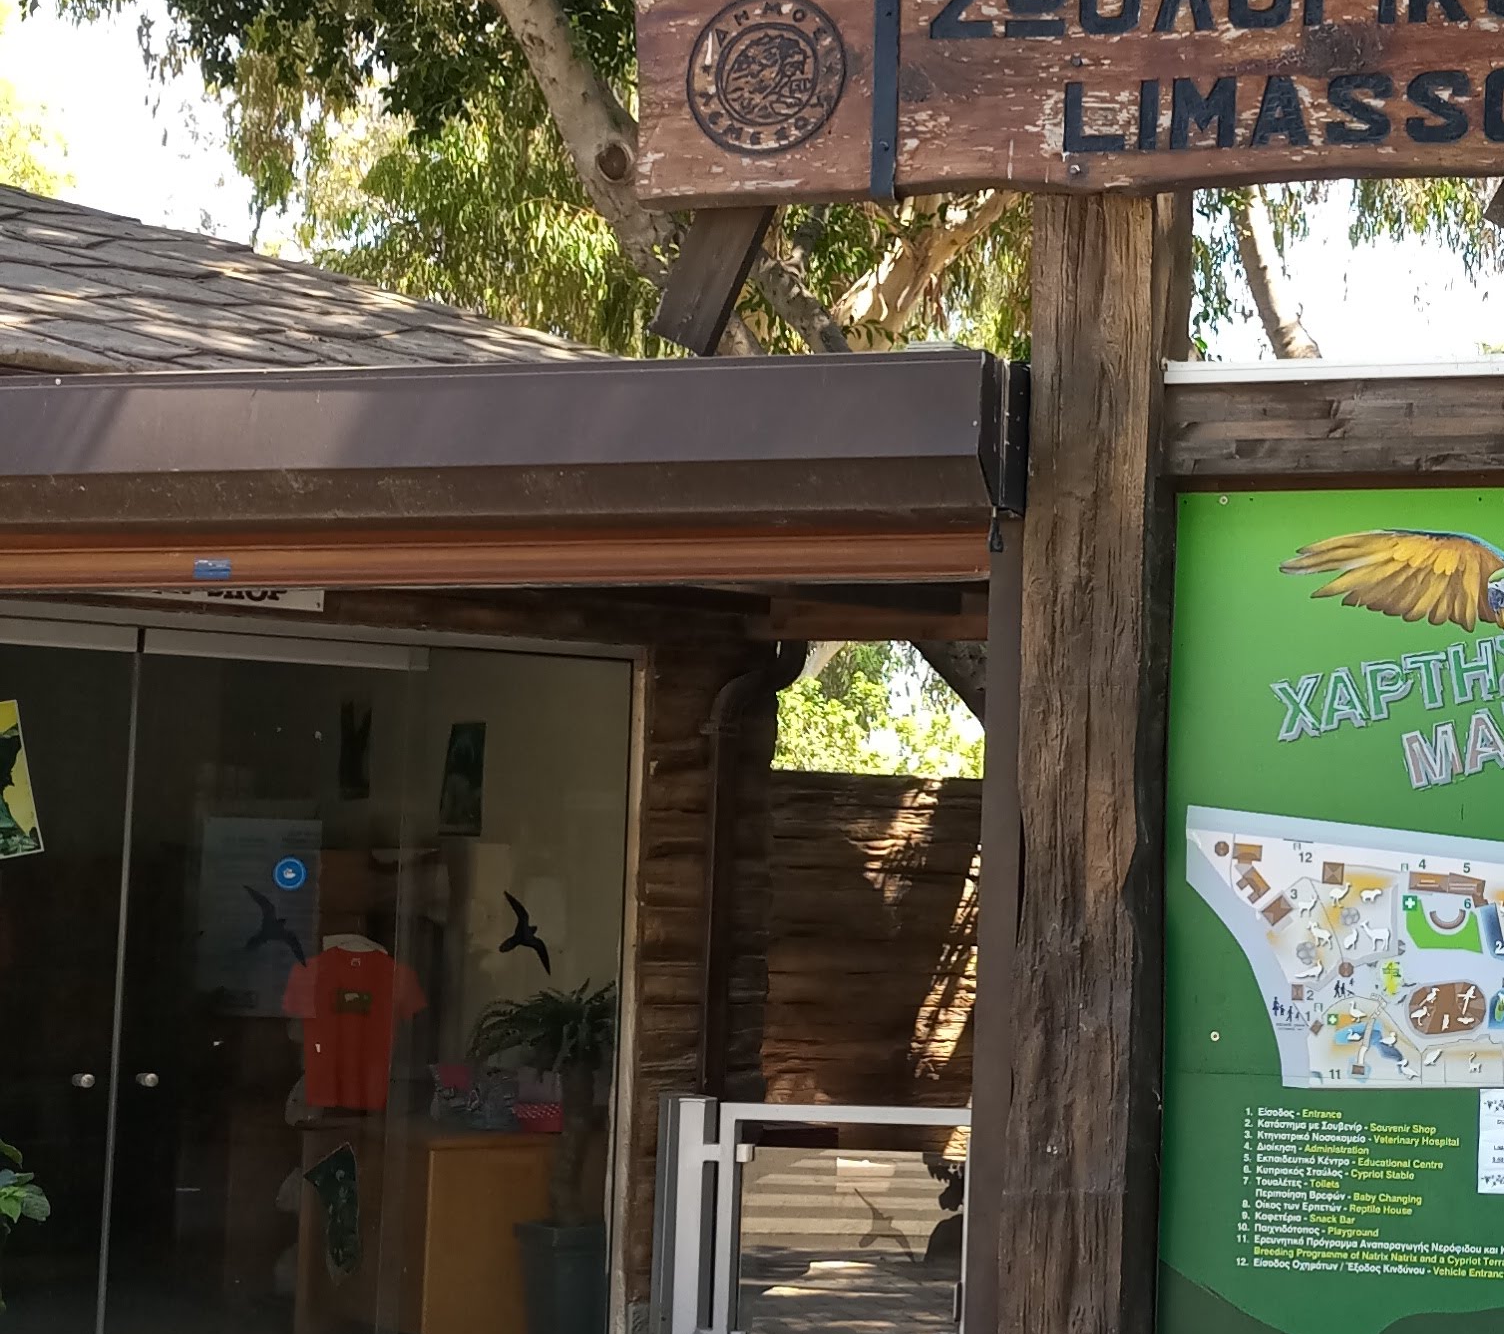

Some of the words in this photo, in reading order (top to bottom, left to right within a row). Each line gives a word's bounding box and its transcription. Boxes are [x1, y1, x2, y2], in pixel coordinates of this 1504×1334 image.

[1298, 852, 1313, 863] 12
[1418, 859, 1427, 870] 4
[1462, 862, 1471, 873] 5
[1290, 888, 1298, 900] 3
[1464, 898, 1472, 910] 6
[1306, 989, 1314, 1001] 2
[1328, 1069, 1341, 1080] 11
[1257, 1107, 1295, 1119] Είσοδος
[1302, 1109, 1342, 1119] Entrance
[1369, 1122, 1411, 1133] Souvenir
[1412, 1124, 1437, 1136] Shop
[1373, 1134, 1420, 1147] Veterinary
[1421, 1136, 1460, 1148] Hospital
[1303, 1144, 1370, 1155] Administration
[1357, 1157, 1411, 1168] Educational
[1412, 1159, 1444, 1169] Centre
[1350, 1168, 1384, 1181] Cypriot
[1386, 1170, 1415, 1180] Stable
[1309, 1179, 1340, 1188] Toilets
[1353, 1192, 1377, 1204] Baby
[1378, 1194, 1423, 1206] Changing
[1349, 1204, 1381, 1215] Reptile
[1382, 1204, 1413, 1216] House
[1309, 1214, 1338, 1223] Snack
[1339, 1215, 1356, 1225] Bar
[1327, 1226, 1379, 1238] Playground
[1484, 1245, 1499, 1255] και
[1253, 1246, 1295, 1258] Breeding
[1296, 1248, 1348, 1260] Programme
[1350, 1251, 1360, 1260] of
[1361, 1251, 1389, 1261] Natrix
[1390, 1253, 1418, 1262] Natrix
[1420, 1255, 1438, 1264] and
[1447, 1255, 1481, 1267] Cypriot
[1253, 1257, 1291, 1270] Είσοδος
[1433, 1266, 1467, 1277] Vehicle
